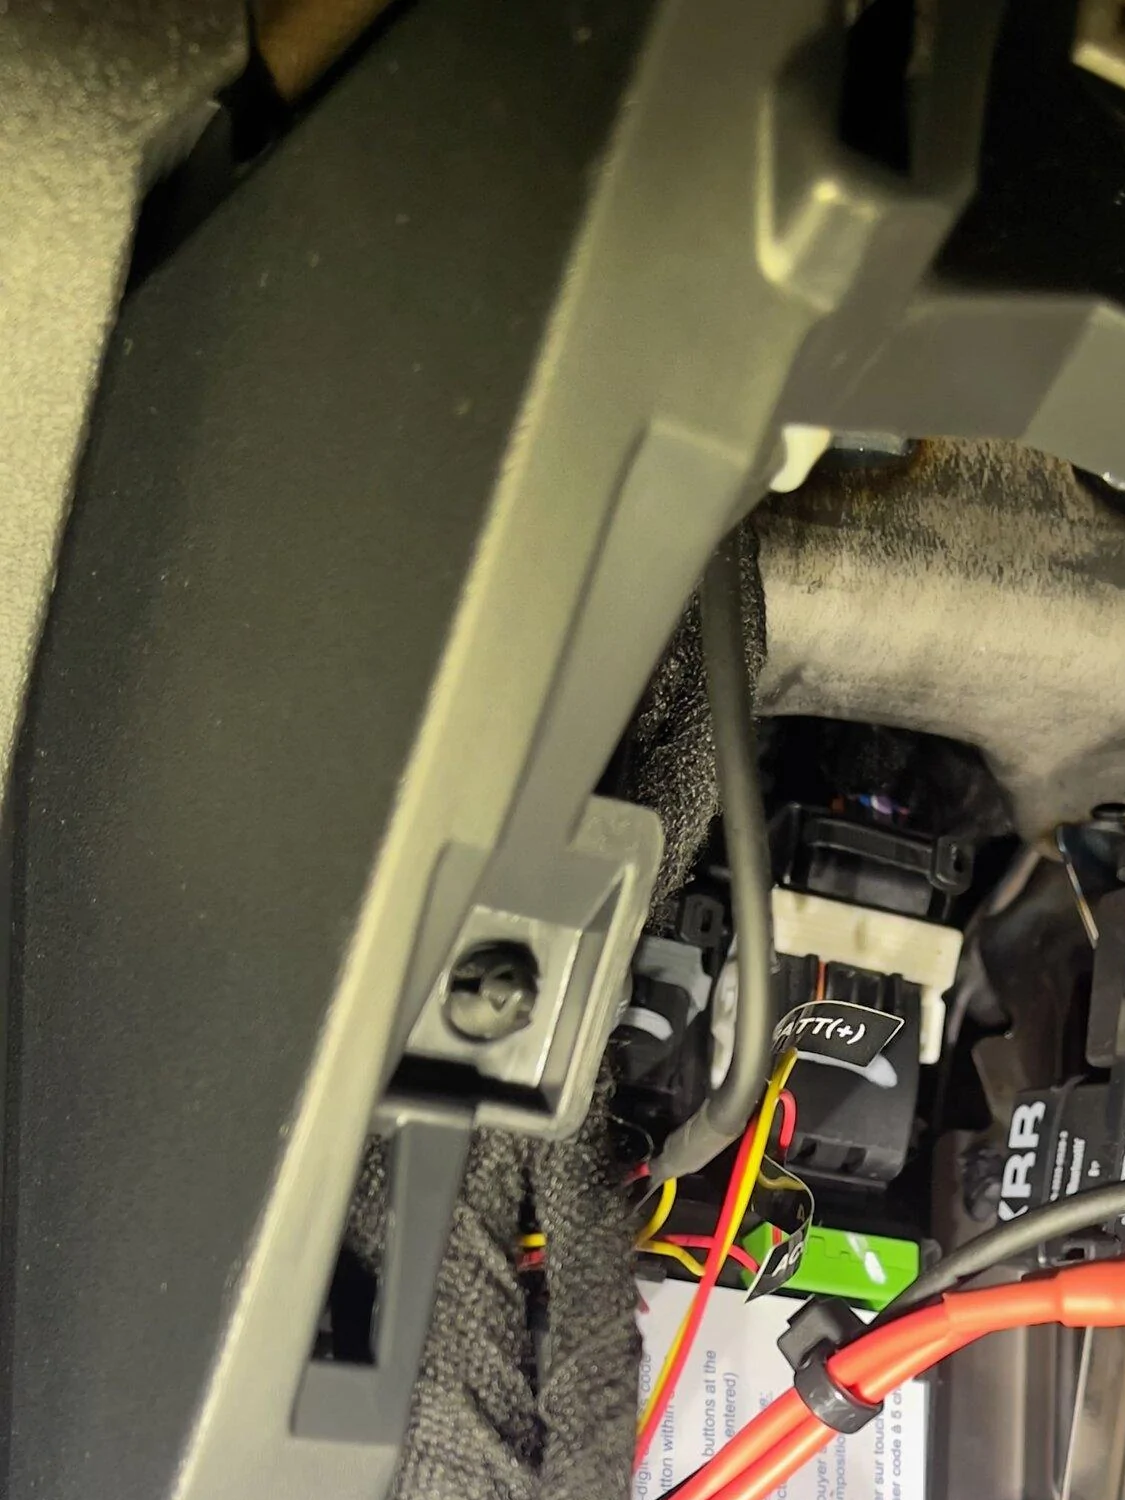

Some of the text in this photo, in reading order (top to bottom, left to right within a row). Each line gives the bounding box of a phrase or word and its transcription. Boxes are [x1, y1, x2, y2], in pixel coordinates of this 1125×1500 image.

[704, 1350, 716, 1374] the
[704, 1379, 716, 1393] at
[892, 1388, 902, 1405] ch
[722, 1372, 739, 1438] entered)
[891, 1410, 902, 1419] 5
[702, 1400, 716, 1457] buttons
[891, 1438, 901, 1476] code
[874, 1460, 884, 1484] sur
